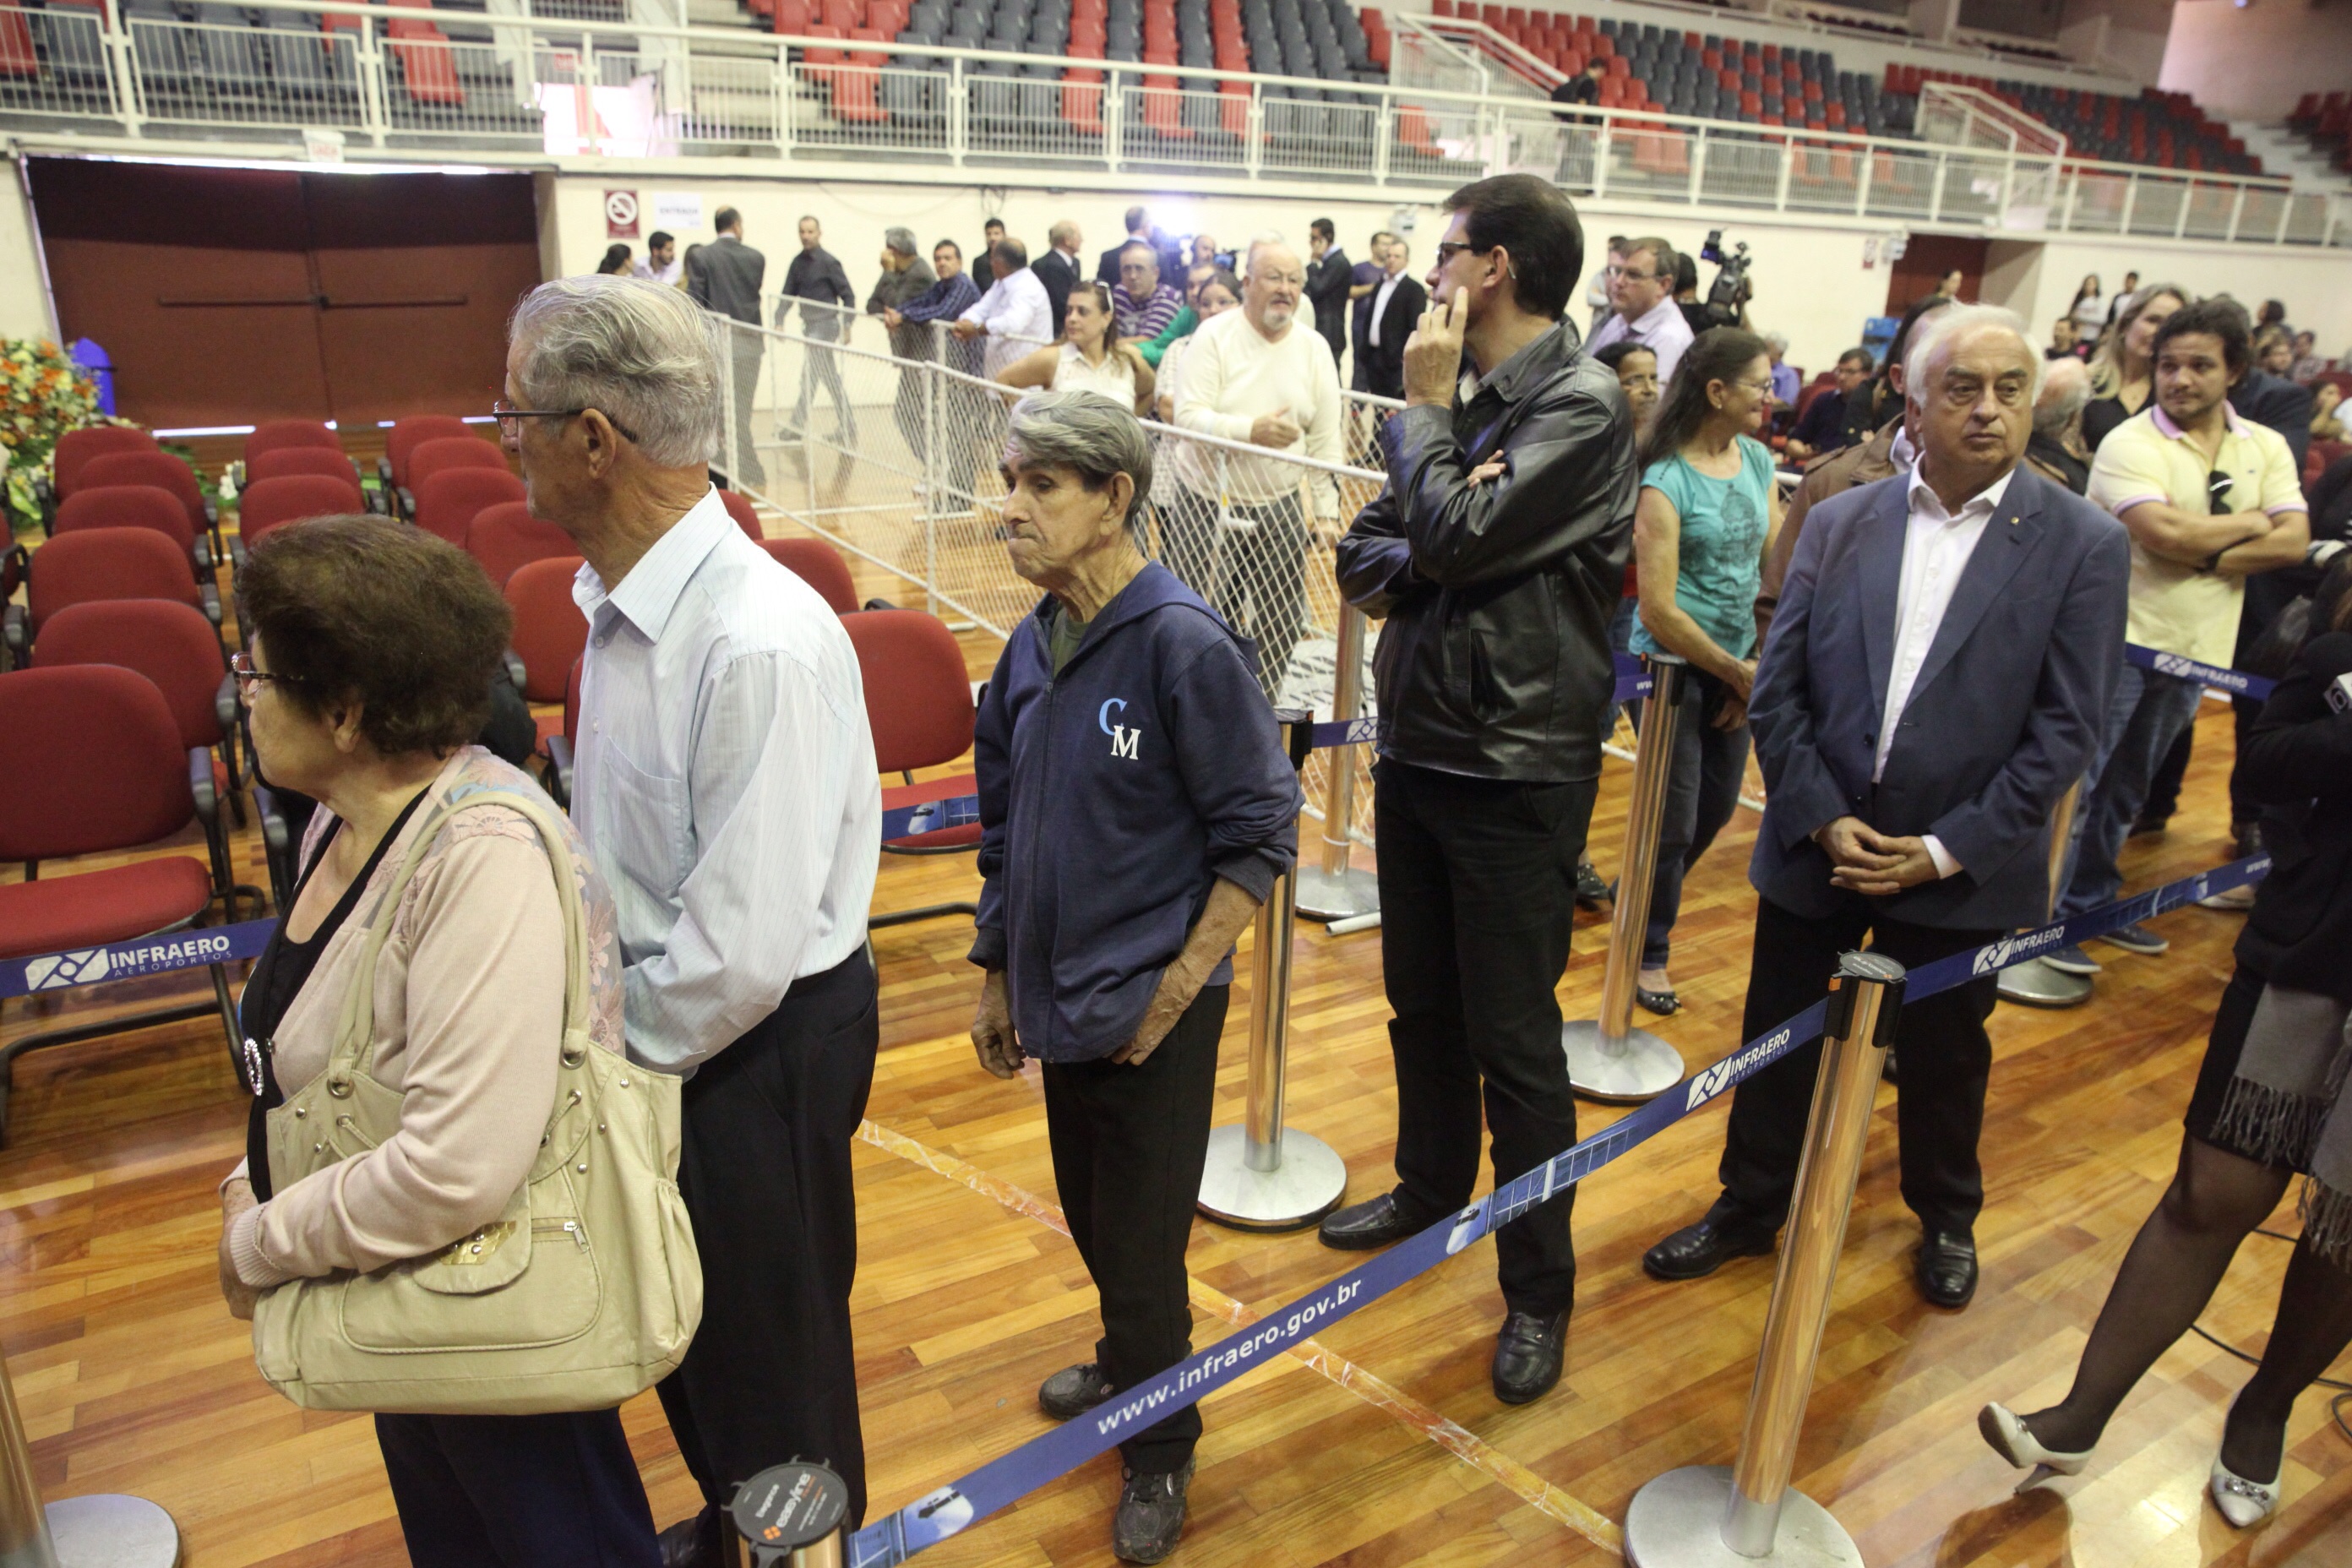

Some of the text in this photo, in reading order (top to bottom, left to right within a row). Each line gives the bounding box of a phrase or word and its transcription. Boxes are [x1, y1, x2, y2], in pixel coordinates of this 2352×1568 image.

[2191, 664, 2249, 689] INFRAERO
[109, 935, 231, 969] INFRAERO
[2011, 926, 2066, 955] INFRAERO
[114, 950, 233, 977] AEROPORTOS
[1728, 1044, 1788, 1086] AEROPORTOS
[1729, 1028, 1791, 1077] INFRAERO
[1097, 1278, 1363, 1435] www.infraero.gov.br
